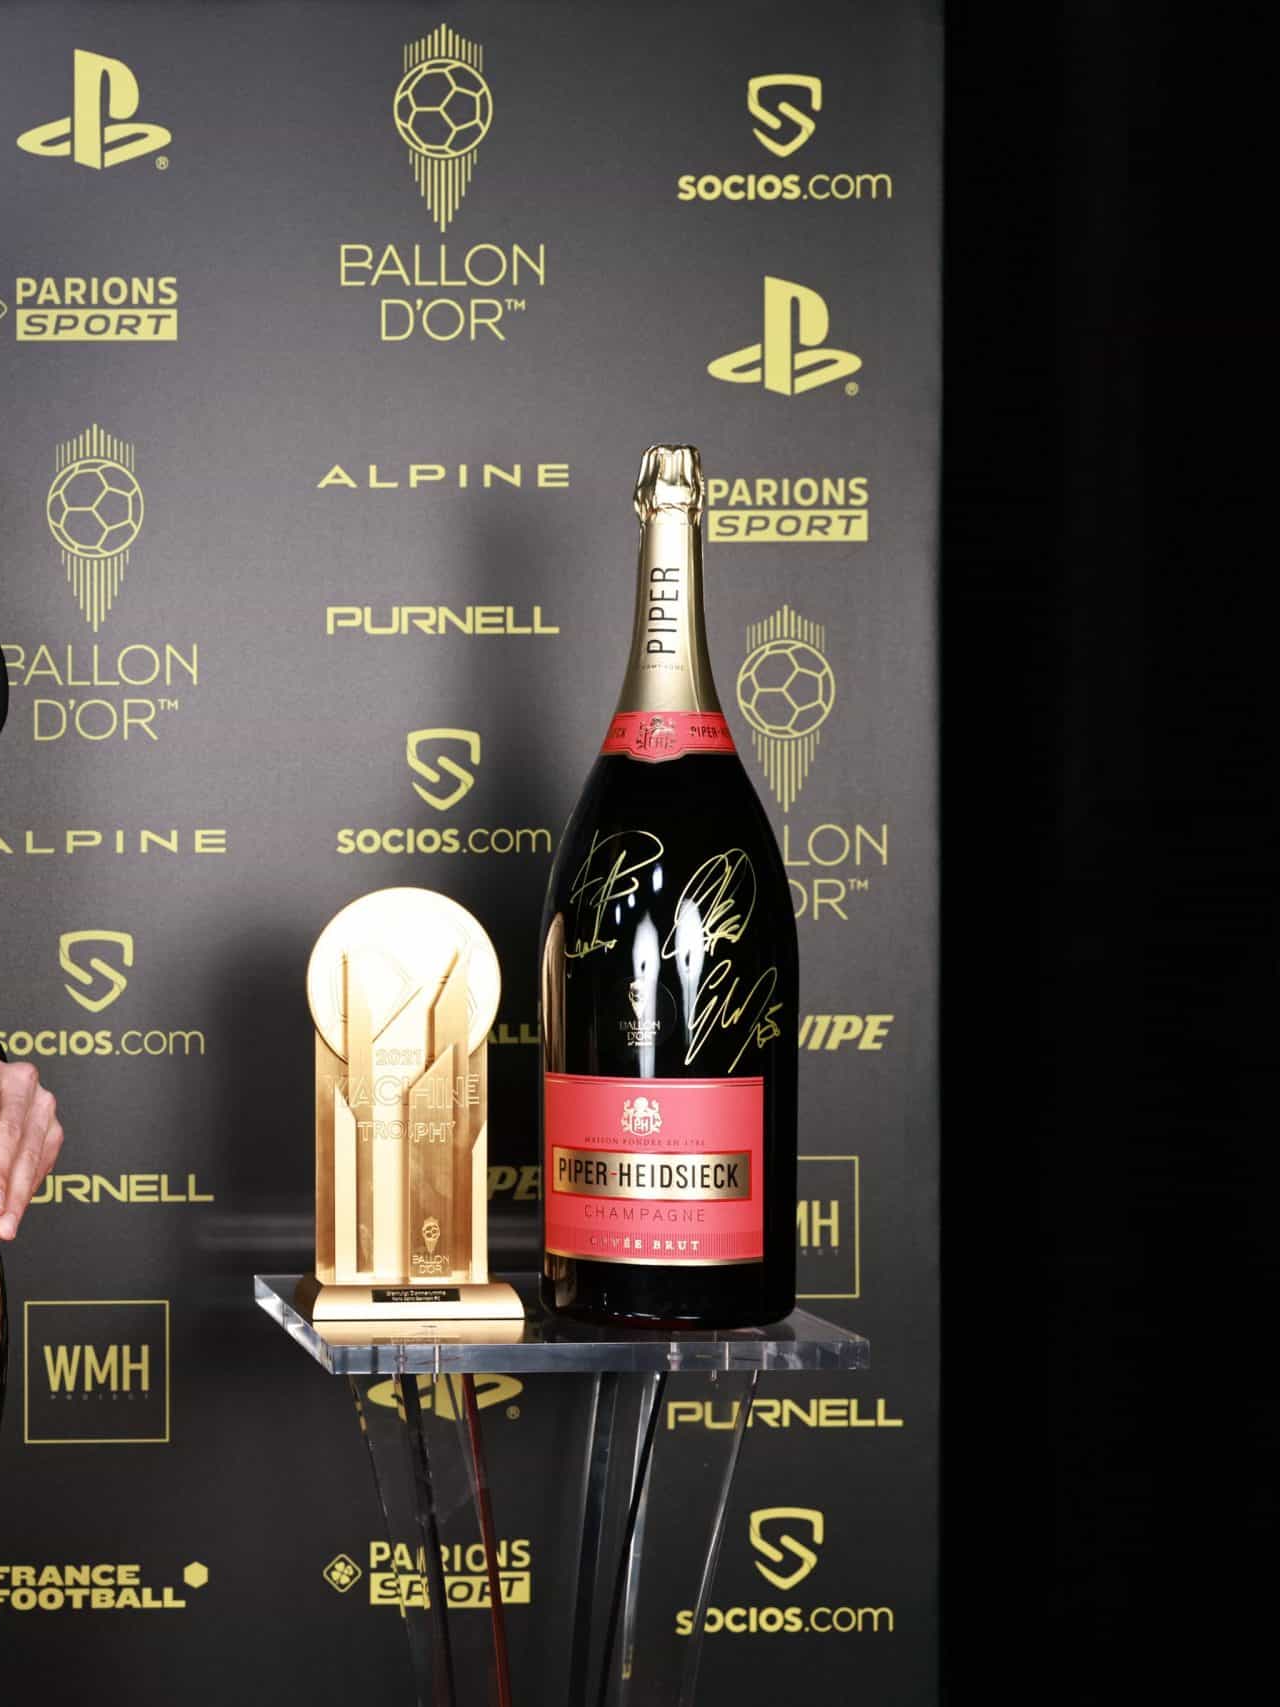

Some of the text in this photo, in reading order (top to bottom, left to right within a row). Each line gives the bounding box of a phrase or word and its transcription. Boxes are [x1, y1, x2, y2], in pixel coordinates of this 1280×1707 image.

[678, 173, 893, 201] SOCIOS.com
[340, 243, 545, 287] BALLON
[16, 276, 177, 305] PARIONS
[23, 313, 172, 336] SPORT
[320, 463, 569, 489] ALPINE
[707, 477, 869, 506] PARIONS
[715, 514, 862, 537] SPORT
[326, 605, 560, 636] PURNELL
[646, 566, 681, 654] PIPER
[336, 827, 552, 854] SOCIOS.com
[559, 1157, 739, 1189] PIPER-HEIDSIECK
[584, 1204, 705, 1223] CHAMPAGNE
[653, 1238, 701, 1251] BRUT
[43, 1344, 150, 1392] WMH
[667, 1398, 905, 1431] PURNELL
[675, 1606, 895, 1636] SOCIOS.com
